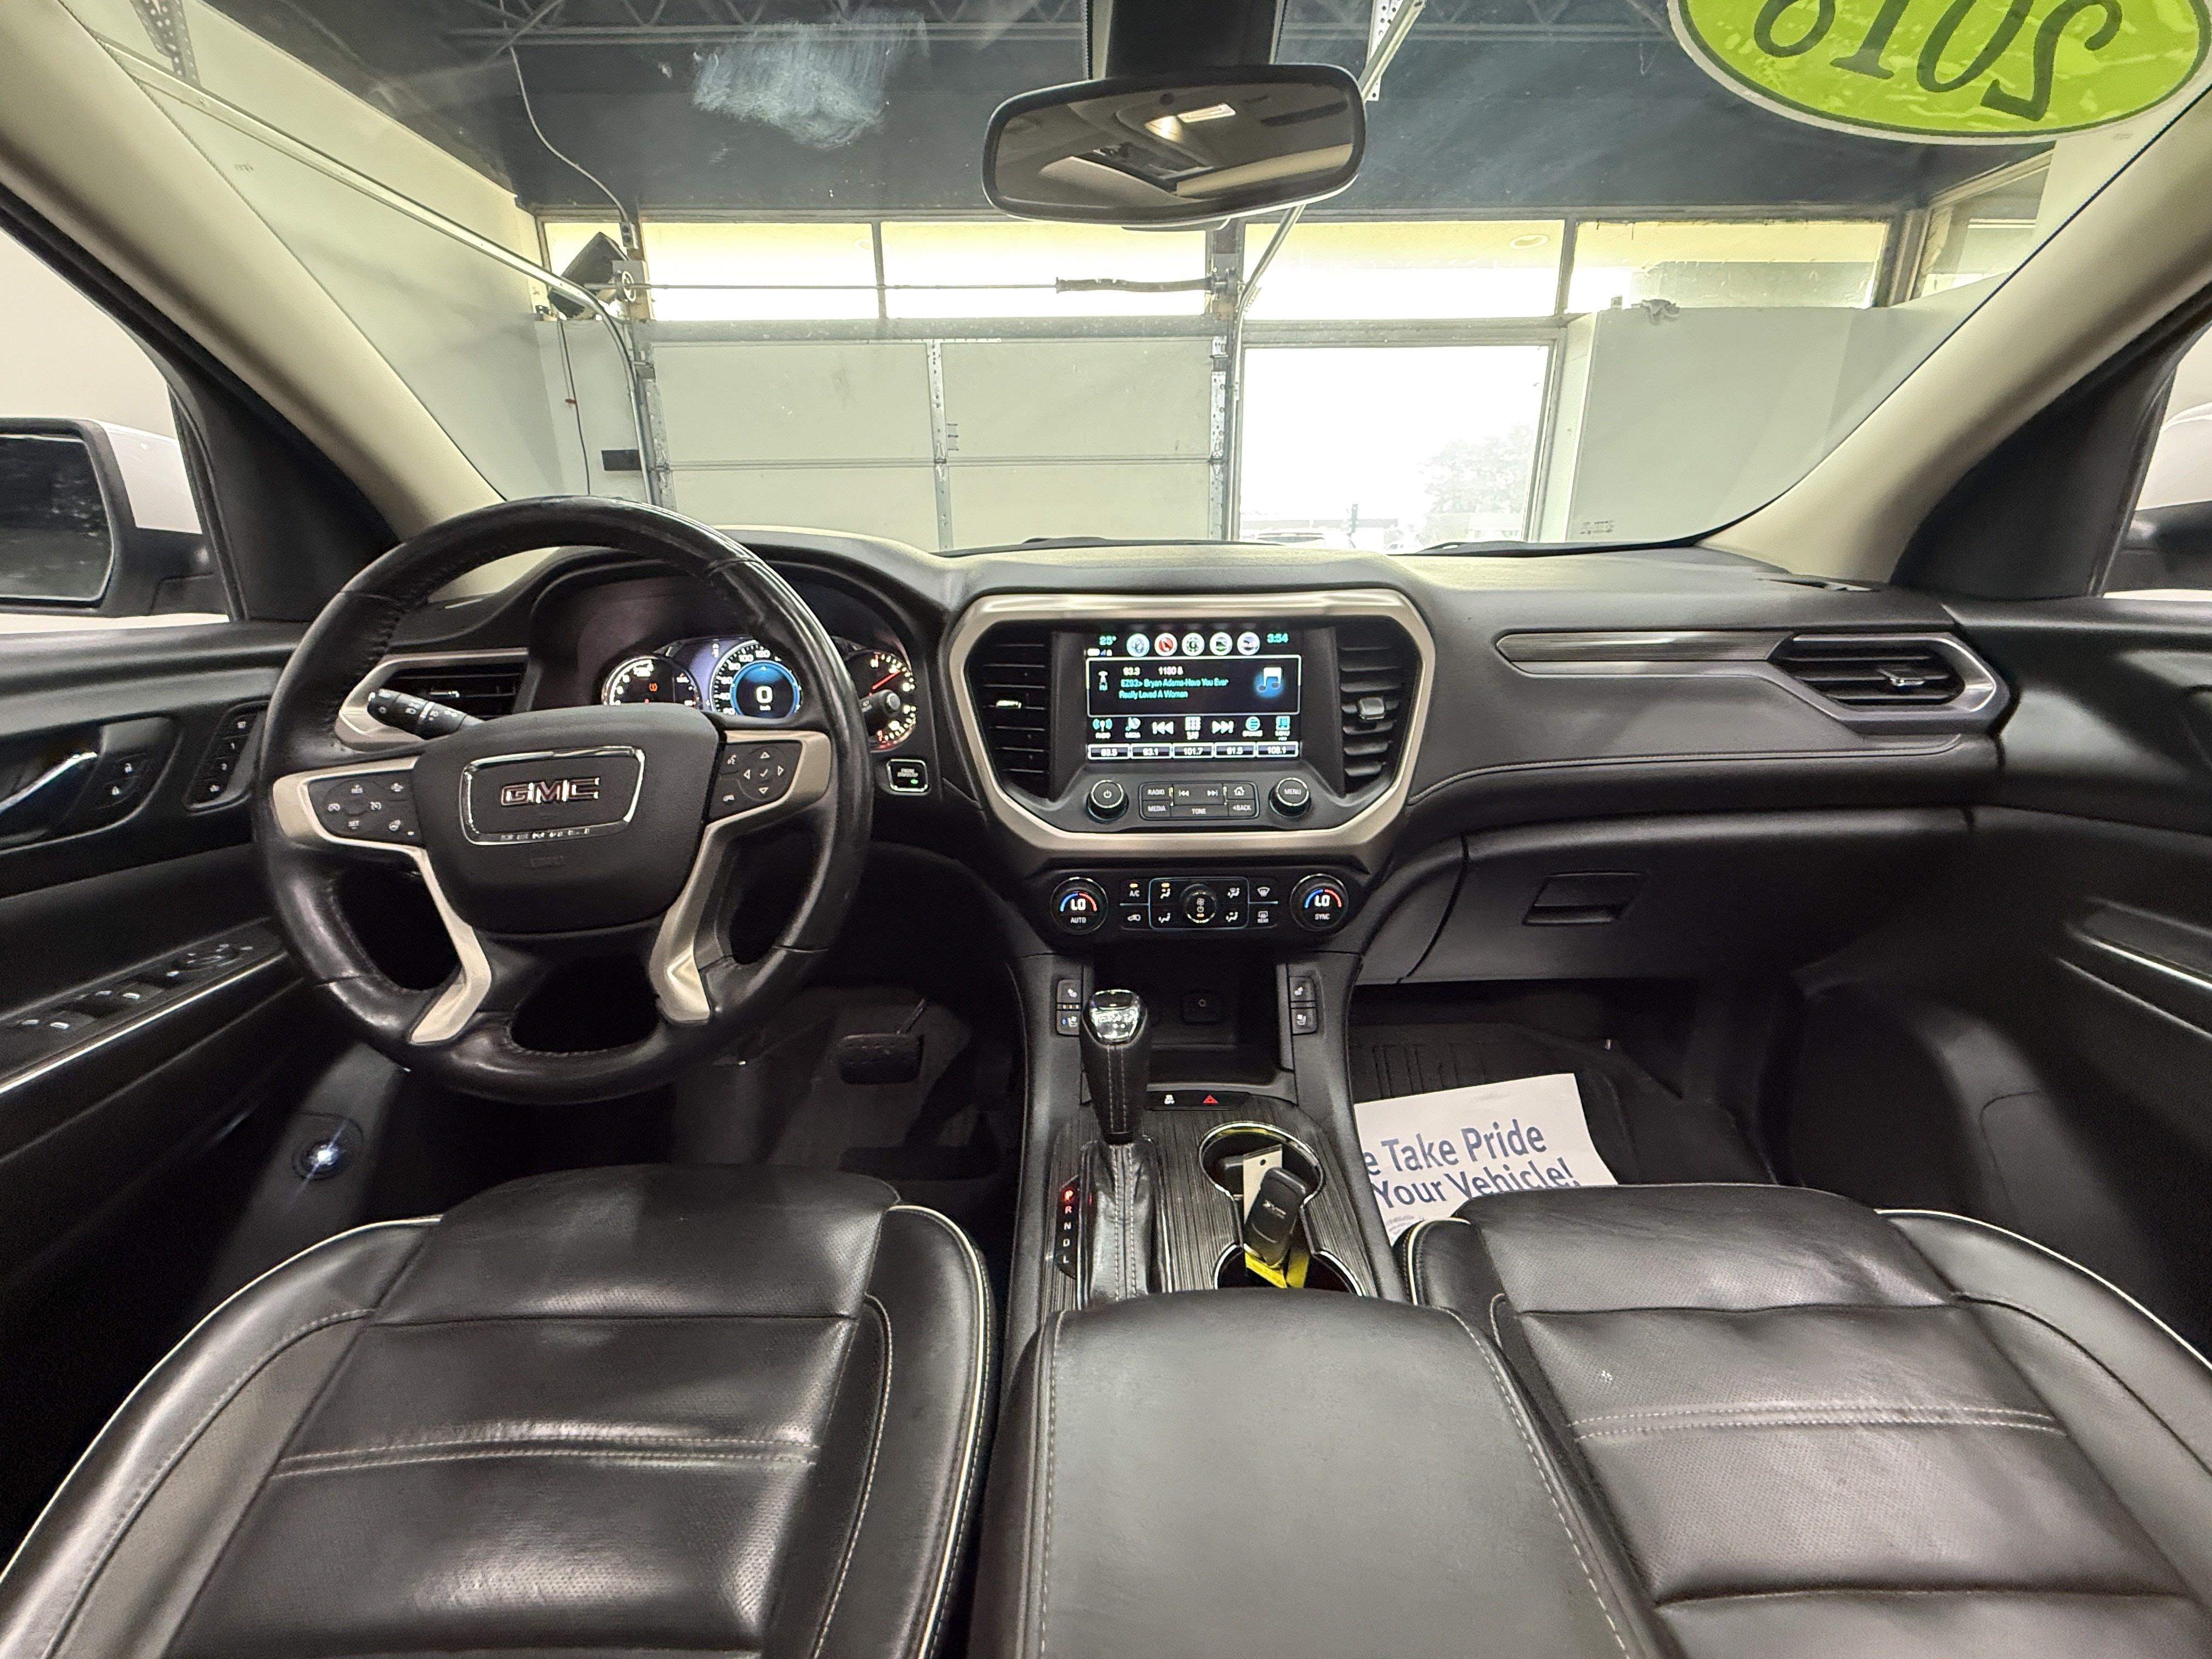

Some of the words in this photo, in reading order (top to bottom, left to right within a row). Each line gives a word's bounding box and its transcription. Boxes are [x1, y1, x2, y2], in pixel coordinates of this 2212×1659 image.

[1144, 678, 1163, 688] Bryan
[1201, 678, 1214, 686] You
[757, 686, 772, 703] 0
[1119, 690, 1138, 700] Really
[1138, 690, 1157, 698] Loved
[1157, 690, 1164, 698] A
[1164, 690, 1188, 698] Woman
[500, 776, 601, 806] GMC
[1071, 898, 1086, 911] LO
[1314, 894, 1330, 907] LO
[1364, 1152, 1381, 1176] e
[1380, 1132, 1459, 1172] Take
[1460, 1119, 1547, 1162] Pride
[1372, 1180, 1447, 1209] Your
[1442, 1157, 1581, 1200] Vehicle!
[1064, 1189, 1074, 1201] P
[1065, 1205, 1073, 1214] R
[1063, 1221, 1071, 1231] N
[1063, 1238, 1070, 1247] D
[1063, 1255, 1069, 1263] L
